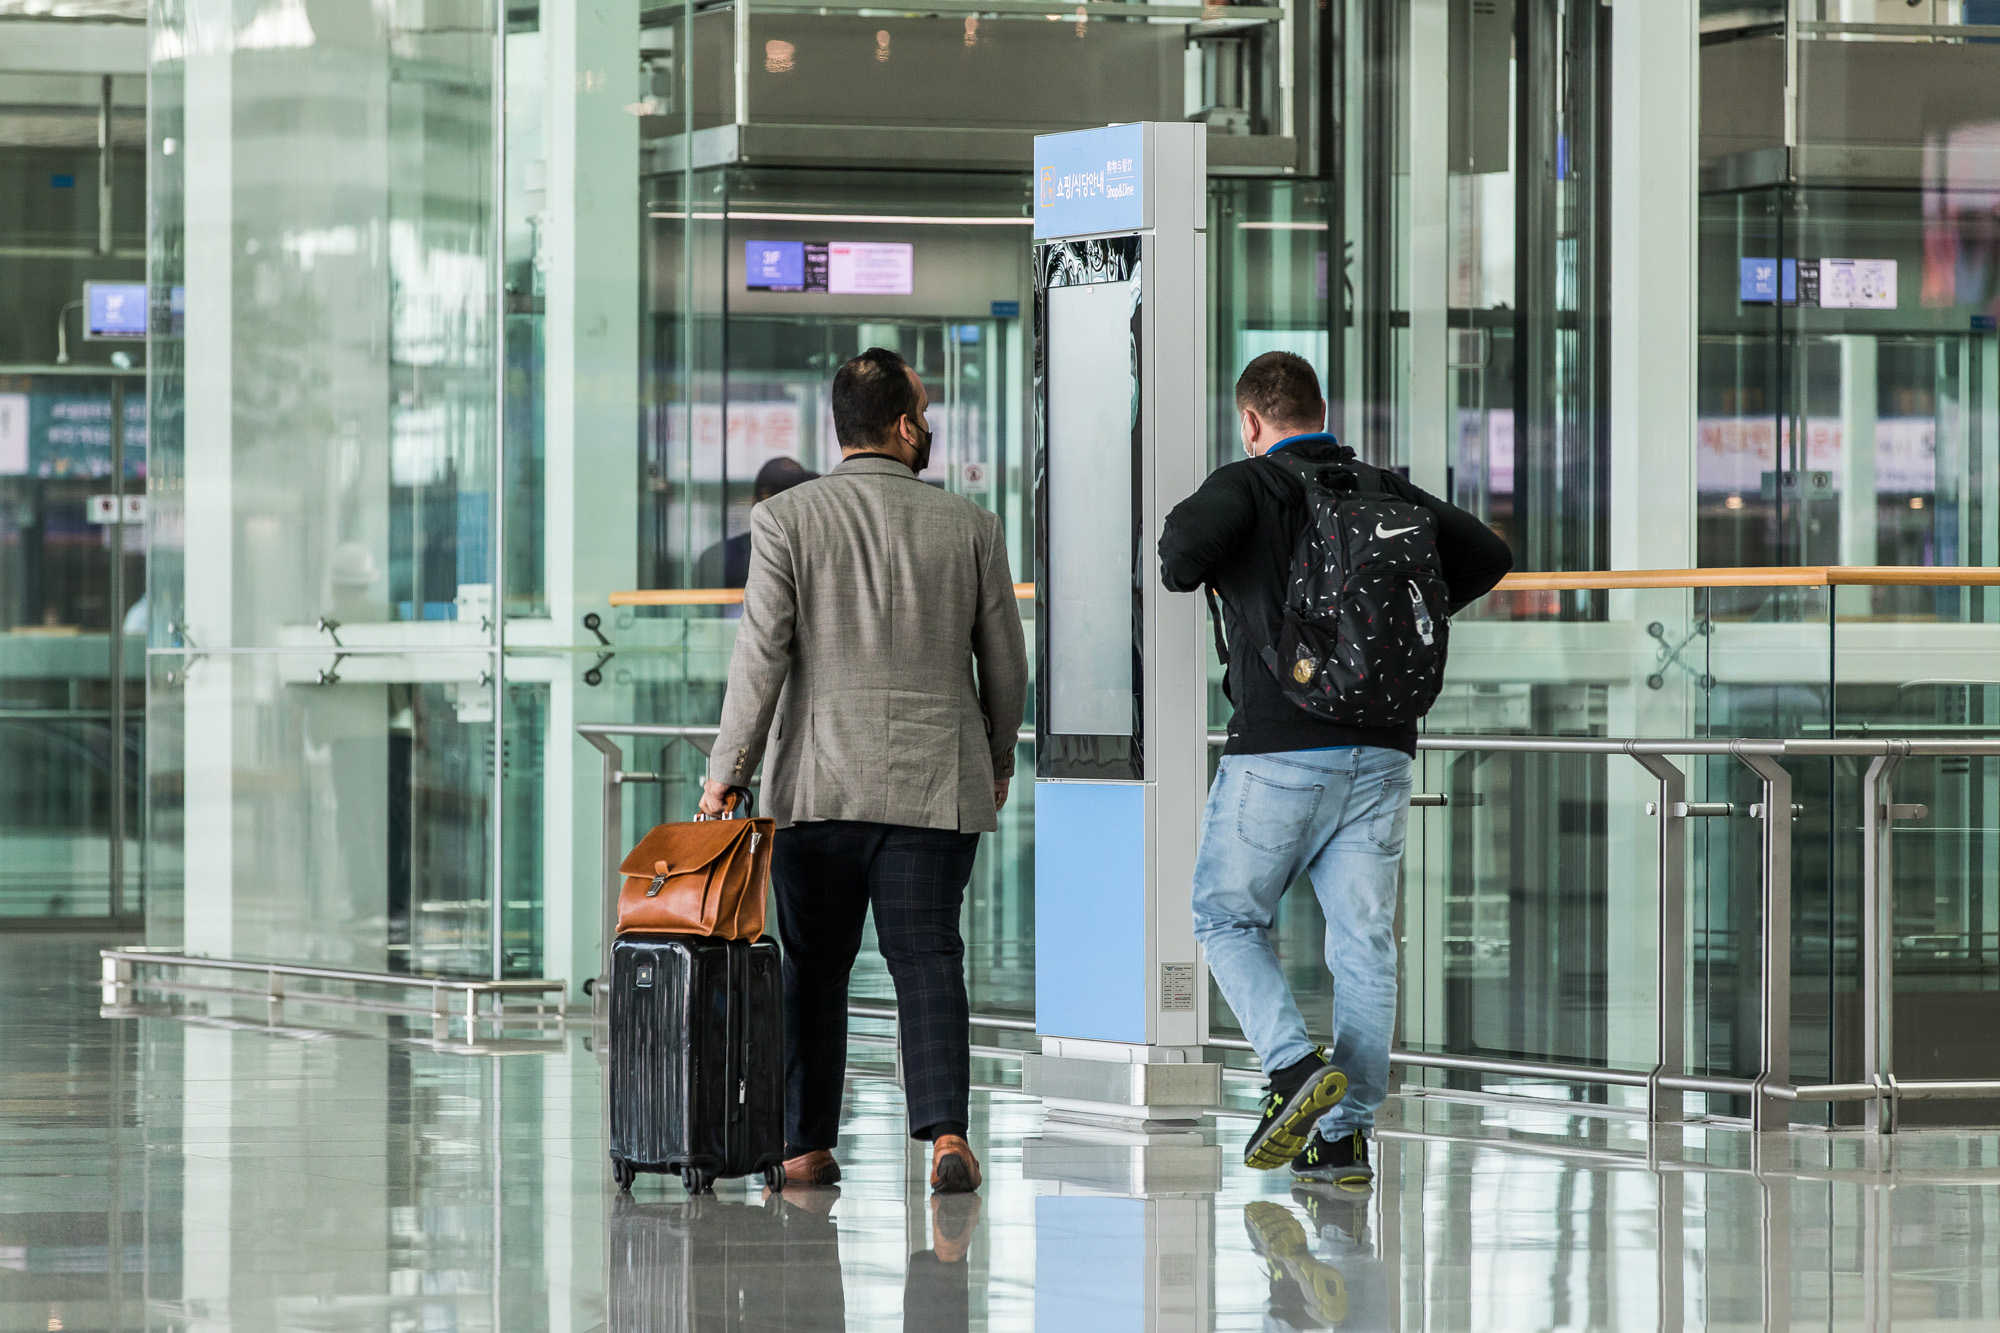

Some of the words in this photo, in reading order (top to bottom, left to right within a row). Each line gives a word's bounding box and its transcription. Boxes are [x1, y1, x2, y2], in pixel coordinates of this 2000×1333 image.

[1107, 157, 1134, 175] 购物与餐饮
[1056, 170, 1105, 200] 쇼핑/식당안내
[1106, 183, 1135, 200] Shop&Dine
[1756, 267, 1772, 281] 3F
